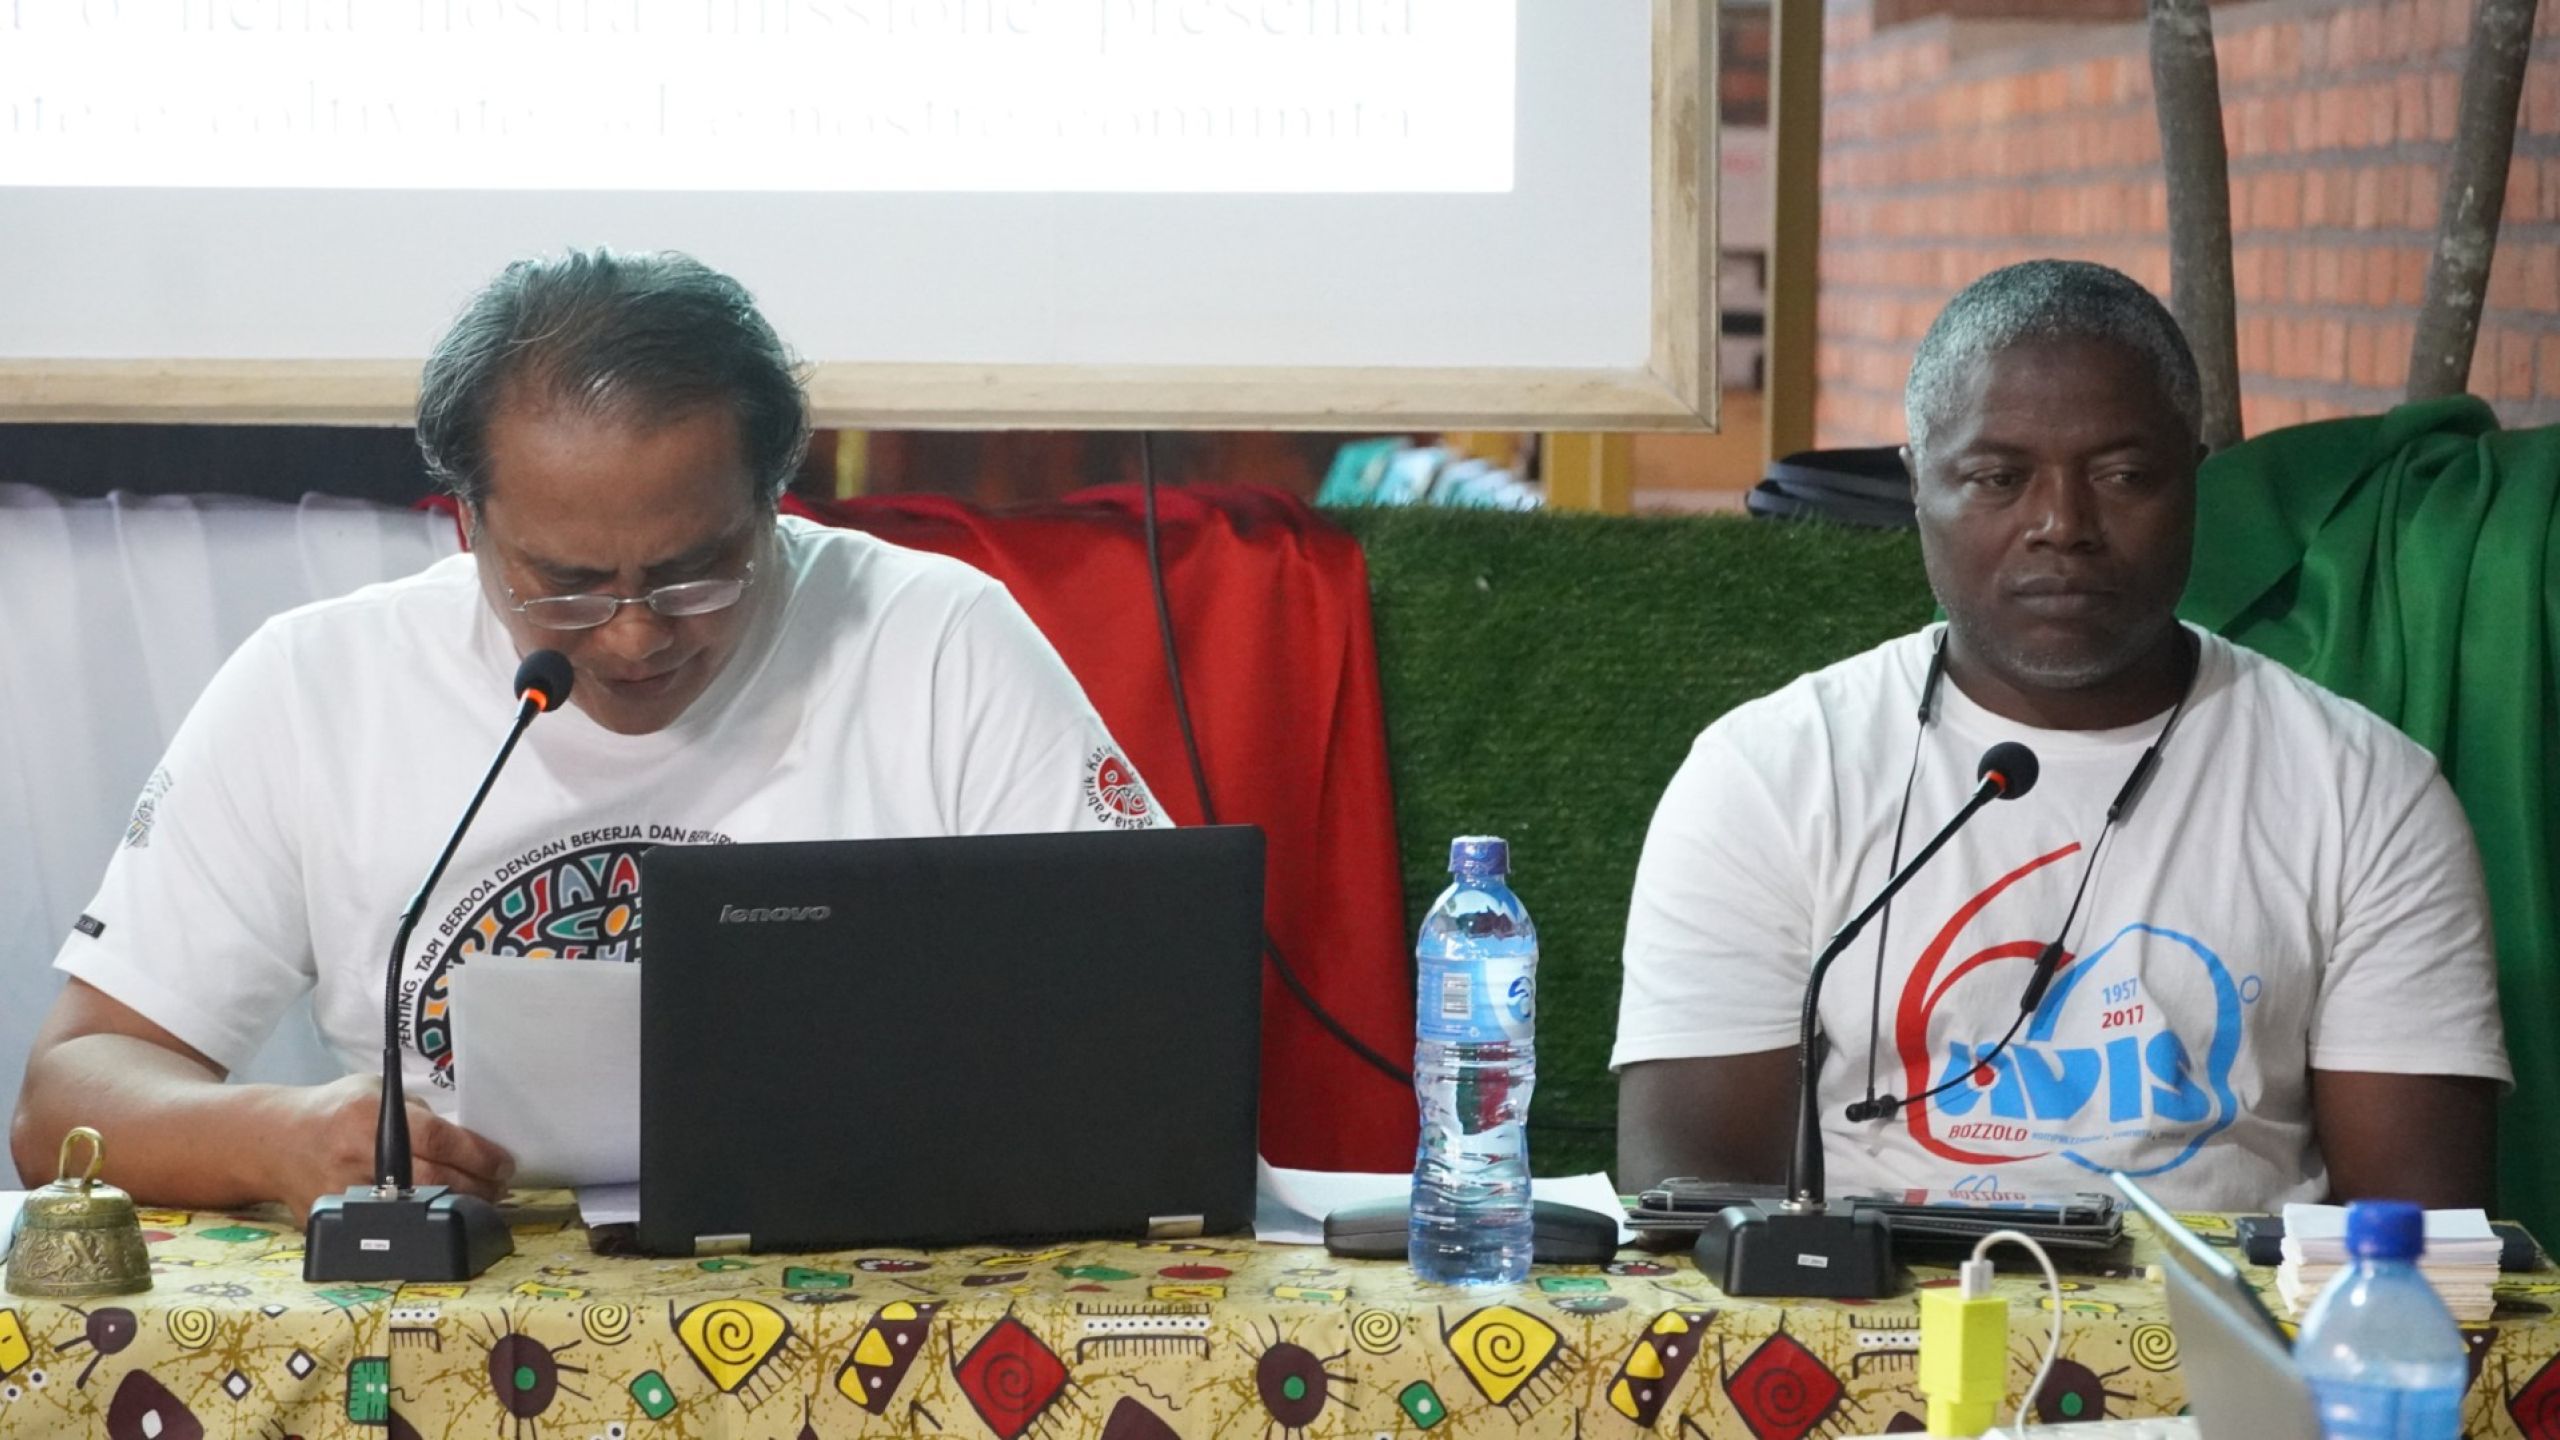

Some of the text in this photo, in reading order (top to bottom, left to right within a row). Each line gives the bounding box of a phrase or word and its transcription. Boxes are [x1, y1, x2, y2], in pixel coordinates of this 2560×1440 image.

[414, 938, 444, 972] TAPI
[438, 878, 497, 937] BERDOA
[494, 839, 567, 882] DENGAN
[570, 824, 643, 848] BEKERJA
[649, 824, 687, 842] DAN
[719, 903, 832, 924] lenovo
[2101, 978, 2138, 1005] 1957
[2101, 1004, 2144, 1029] 2017
[1948, 1123, 2028, 1142] BOZZOLO
